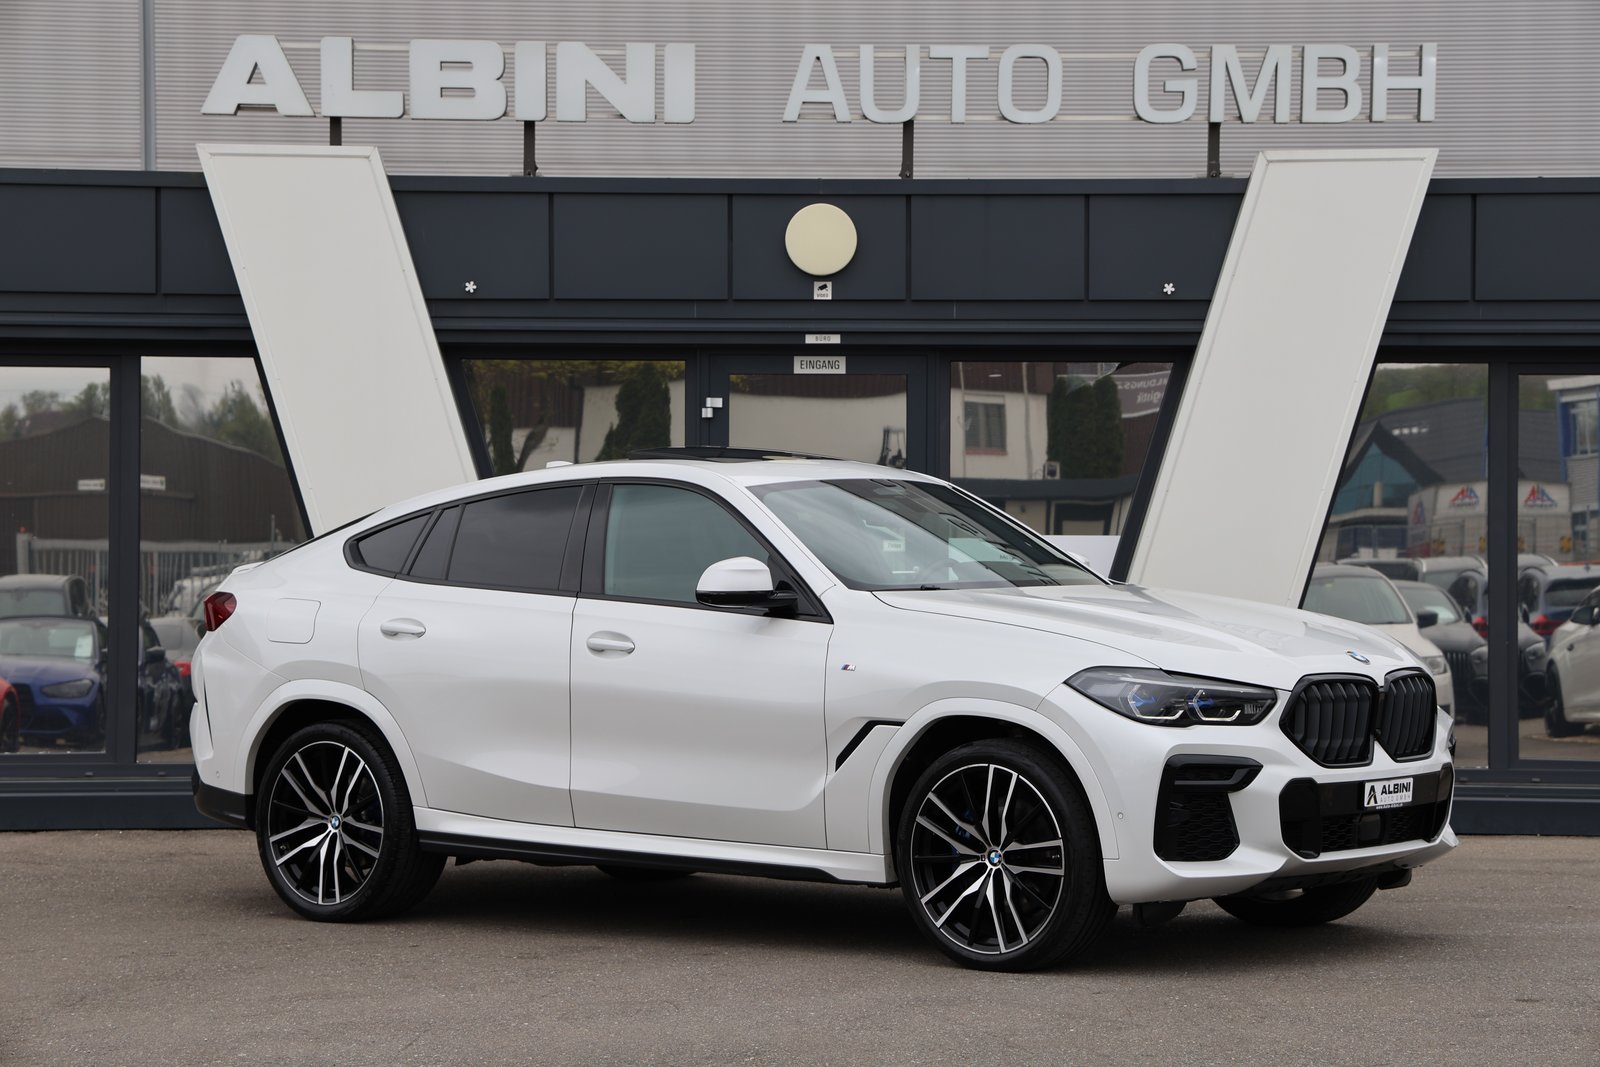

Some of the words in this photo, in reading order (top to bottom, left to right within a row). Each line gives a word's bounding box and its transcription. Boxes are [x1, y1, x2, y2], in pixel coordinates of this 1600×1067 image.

[201, 34, 697, 124] ALBINI
[782, 43, 1063, 124] AUTO
[1133, 42, 1438, 124] GMBH
[800, 360, 840, 370] EINGANG
[1380, 782, 1411, 795] ALBINI
